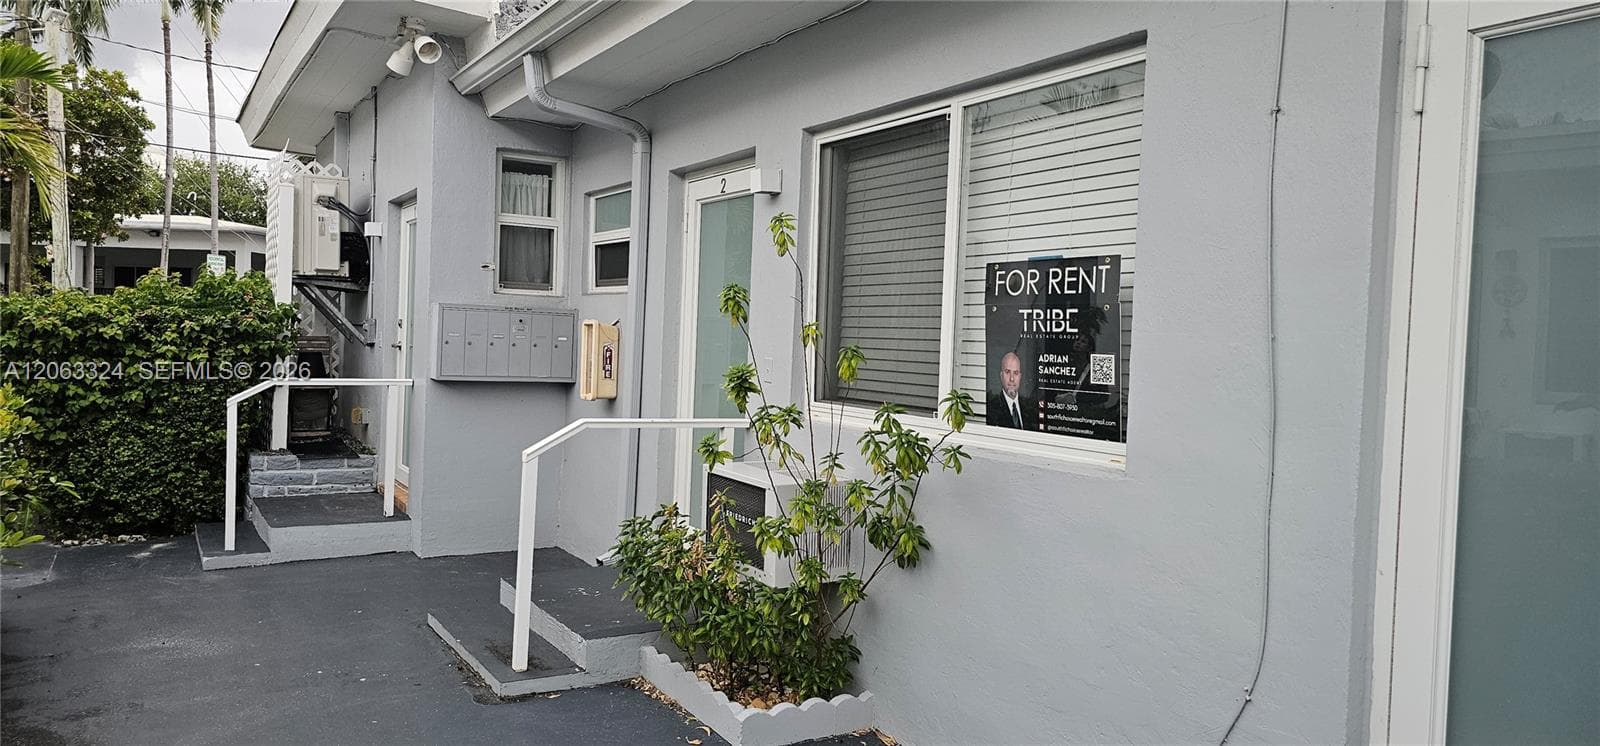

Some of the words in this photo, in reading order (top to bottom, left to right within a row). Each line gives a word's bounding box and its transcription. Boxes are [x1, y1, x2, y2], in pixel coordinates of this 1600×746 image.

[720, 178, 727, 193] 2
[995, 269, 1039, 296] FOR
[1048, 265, 1111, 295] RENT
[1018, 308, 1079, 332] TRIBE
[1038, 353, 1069, 363] ADRIAN
[1038, 365, 1077, 376] SANCHEZ
